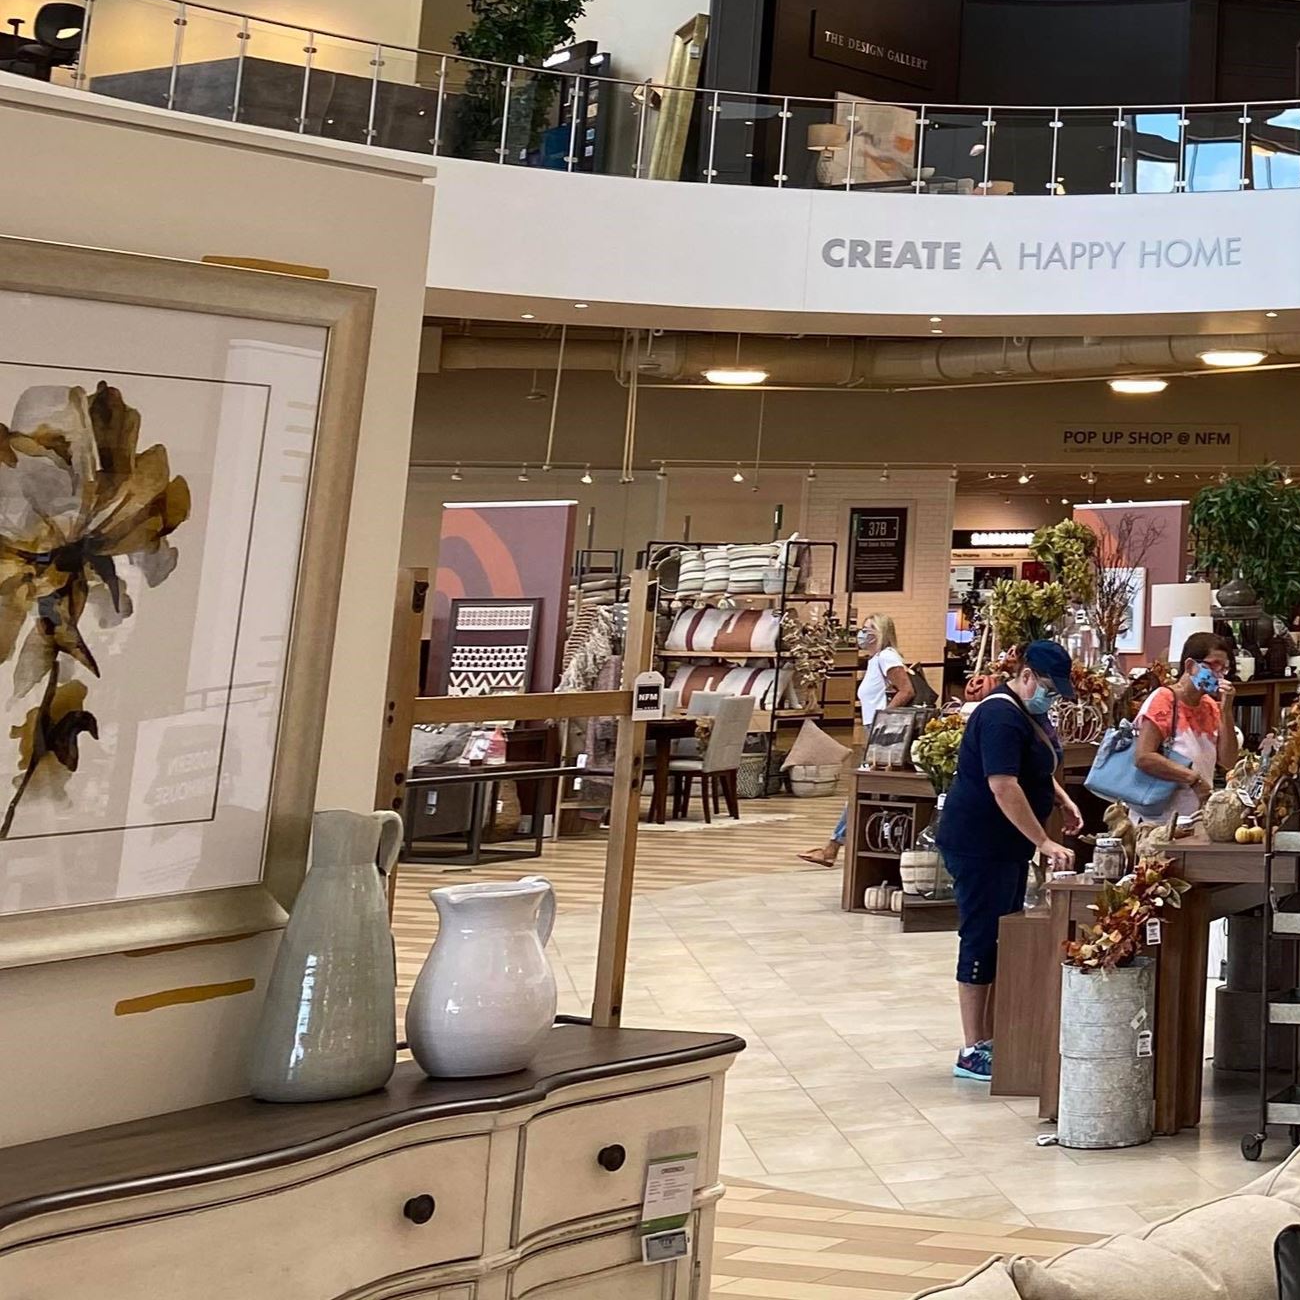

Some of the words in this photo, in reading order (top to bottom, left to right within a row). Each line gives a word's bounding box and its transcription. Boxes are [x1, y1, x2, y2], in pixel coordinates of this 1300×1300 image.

[824, 30, 845, 46] THE
[848, 37, 884, 58] DESIGN
[887, 49, 929, 70] GALLERY
[821, 237, 962, 271] CREATE
[976, 241, 1002, 271] A
[1019, 241, 1126, 271] HAPPY
[1138, 236, 1243, 270] HOME
[1063, 430, 1097, 445] POP
[1102, 431, 1124, 445] UP
[1128, 431, 1173, 445] SHOP
[1177, 432, 1190, 445] @
[1195, 432, 1231, 445] NFM
[638, 693, 658, 701] NFM
